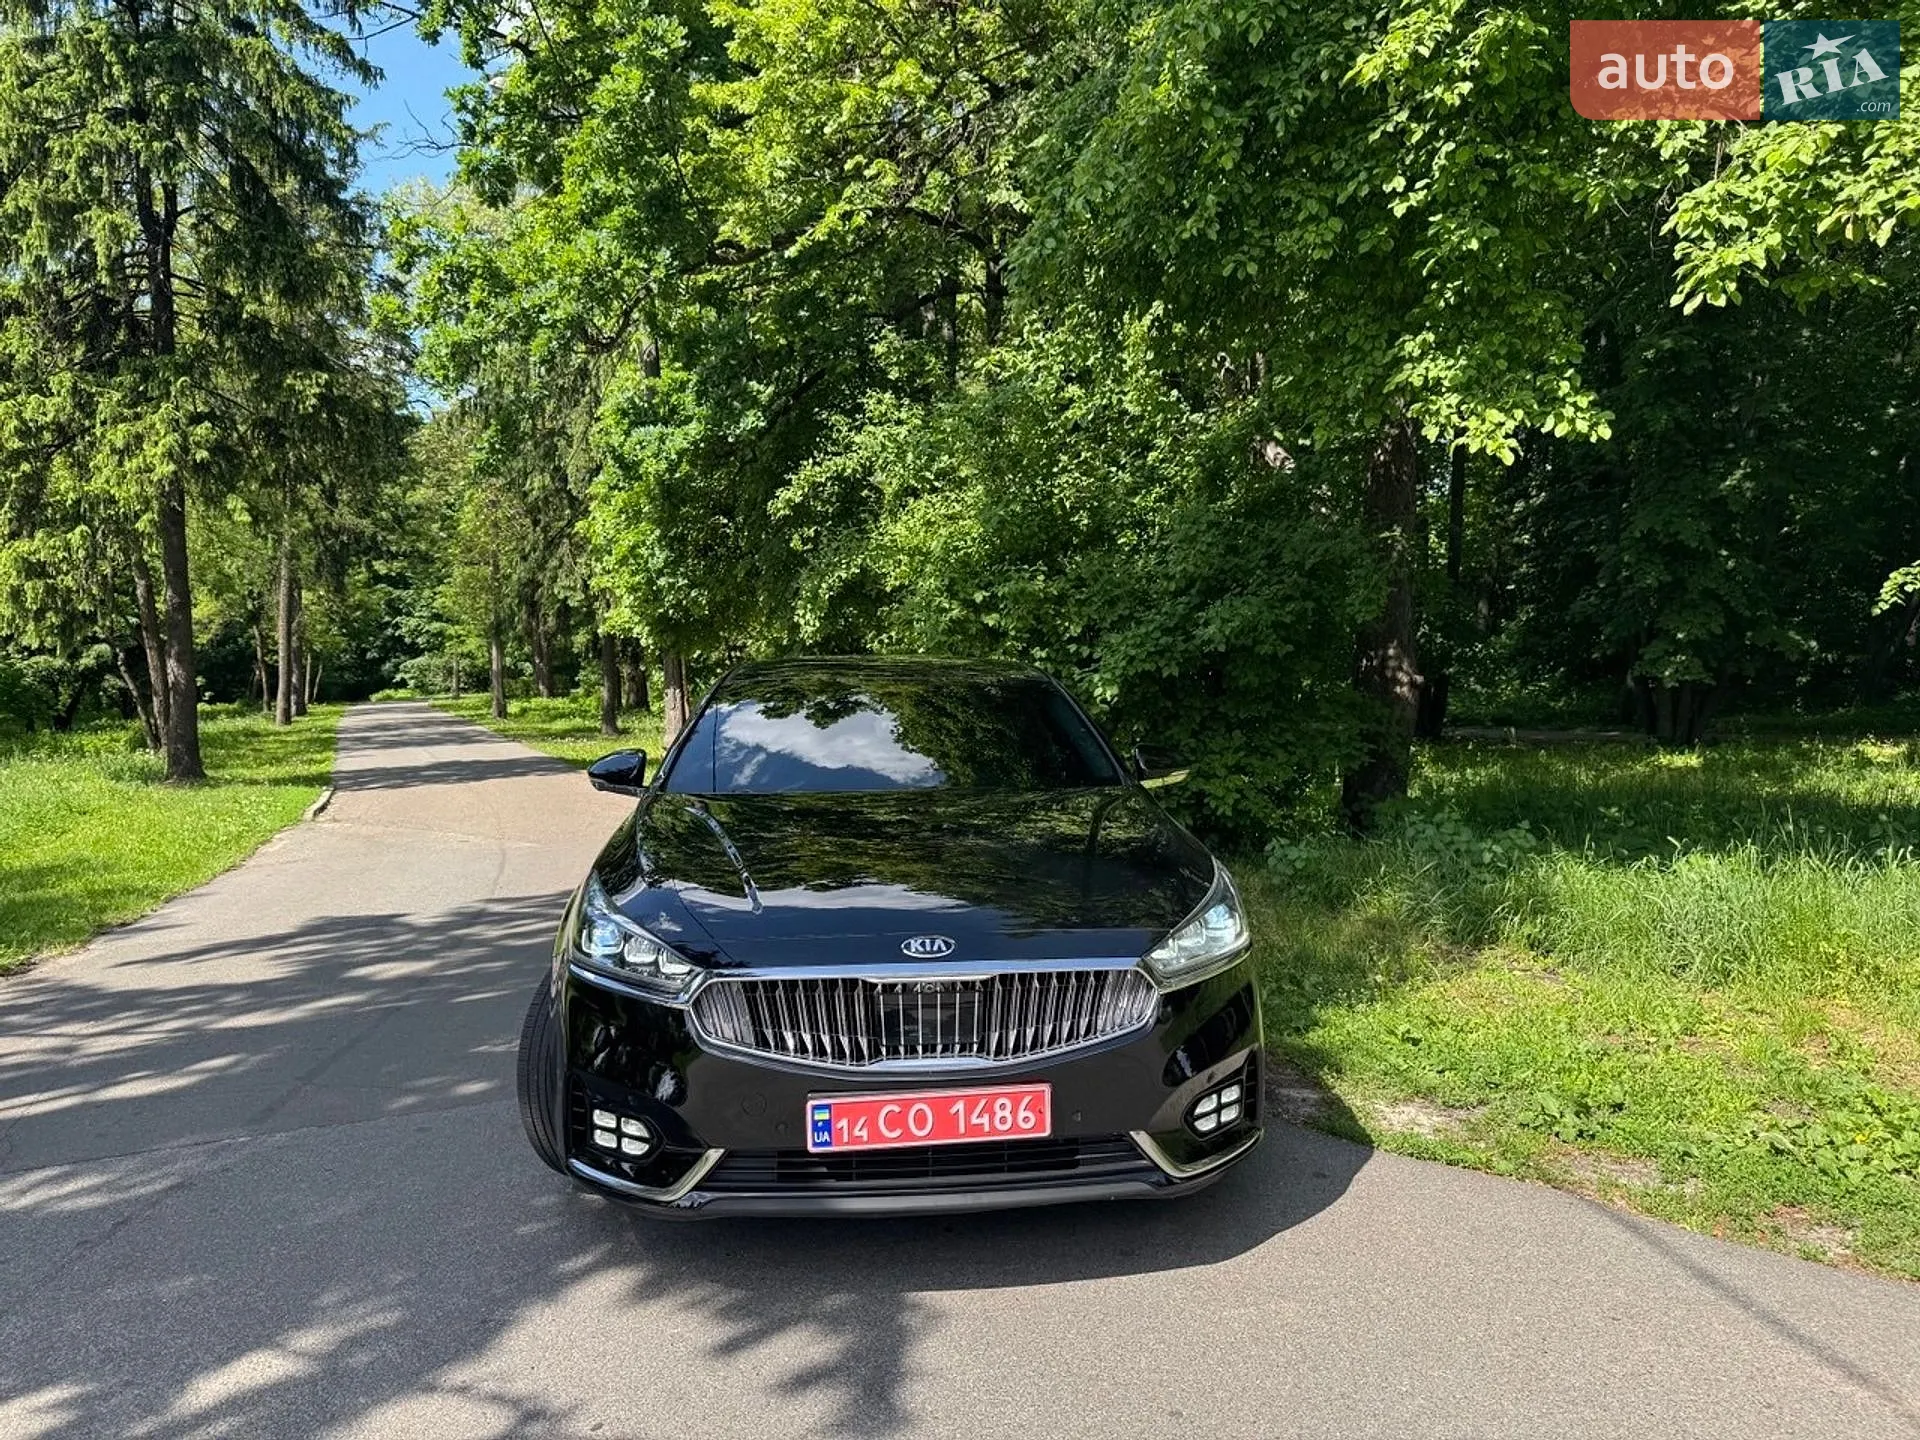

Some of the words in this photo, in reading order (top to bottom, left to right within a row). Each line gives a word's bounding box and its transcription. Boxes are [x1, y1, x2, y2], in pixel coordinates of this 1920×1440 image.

[910, 939, 947, 952] KIA
[835, 1115, 869, 1143] 14
[877, 1102, 934, 1138] CO
[949, 1095, 1036, 1135] 1486
[814, 1131, 831, 1143] UA
